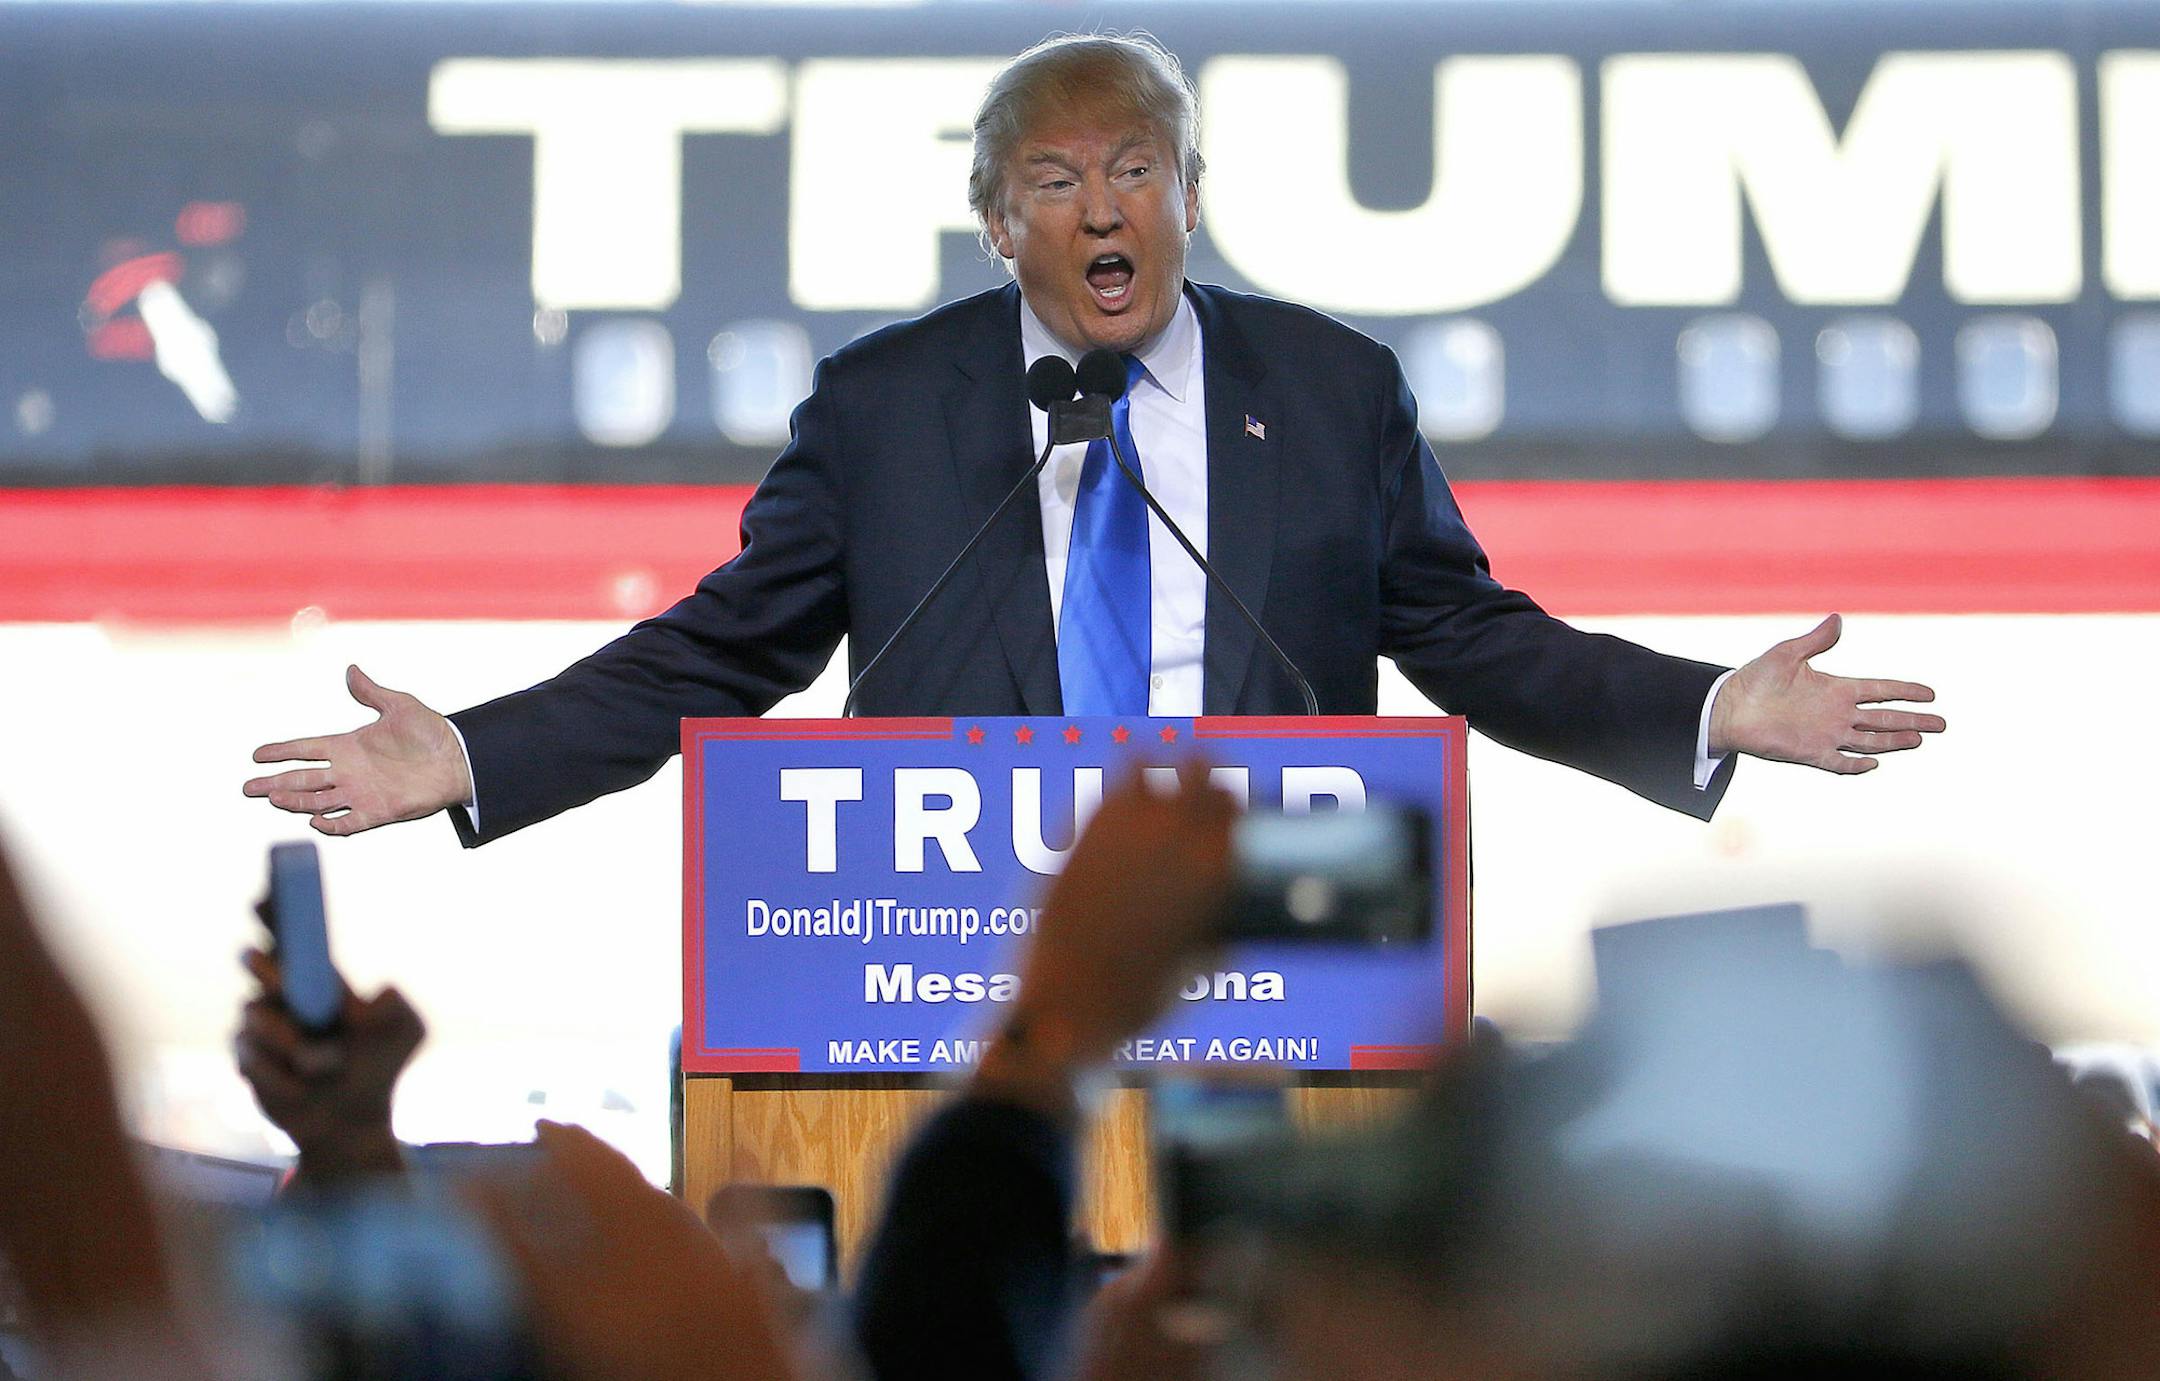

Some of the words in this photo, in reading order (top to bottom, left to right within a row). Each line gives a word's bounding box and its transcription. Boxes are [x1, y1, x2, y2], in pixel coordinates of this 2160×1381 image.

[428, 51, 2160, 315] TRUM
[779, 766, 1367, 875] TRU
[864, 964, 1023, 1003] Mesa
[828, 1040, 920, 1064] MAKE
[1112, 1037, 1197, 1062] REAT
[1204, 1037, 1319, 1062] AGAIN!
